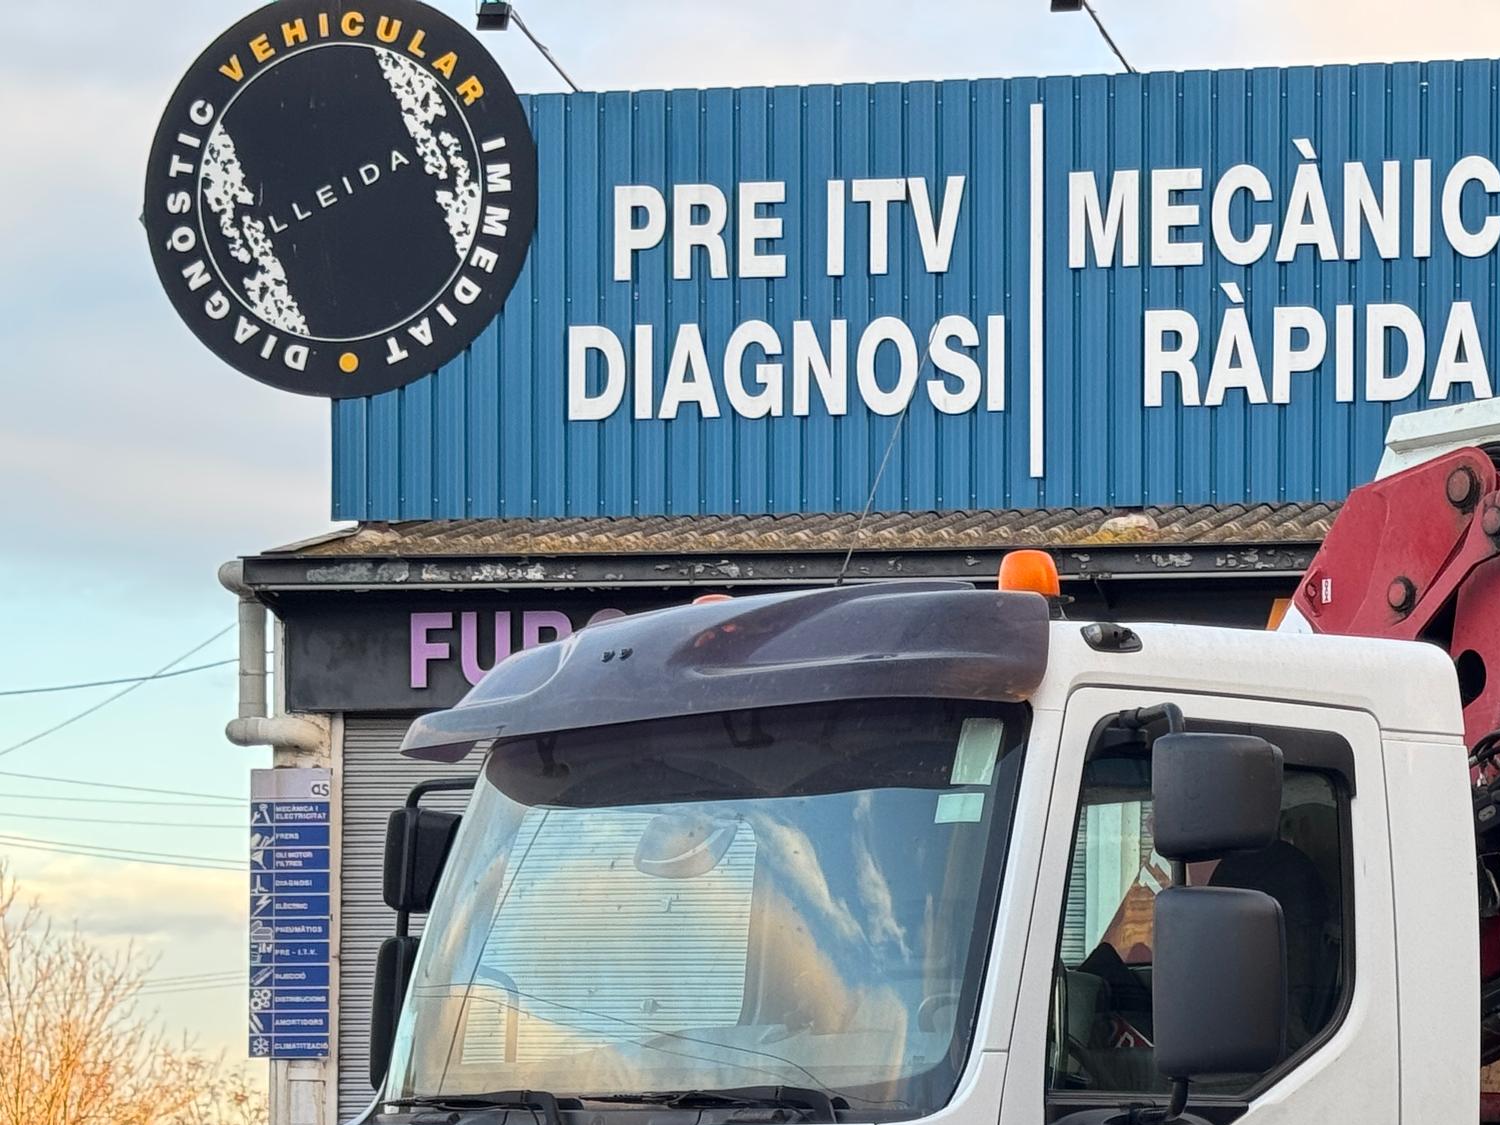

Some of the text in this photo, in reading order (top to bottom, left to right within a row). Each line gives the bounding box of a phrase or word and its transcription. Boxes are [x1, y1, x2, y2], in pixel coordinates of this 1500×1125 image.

[219, 11, 485, 106] VEHICULAR
[167, 99, 311, 371] DIAGNÒSTIC
[268, 150, 409, 234] LLEIDA
[614, 175, 965, 281] PRE ITV
[386, 137, 512, 364] IMMEDIAT
[568, 315, 1005, 421] DIAGNOSI
[1143, 282, 1493, 407] RÀPIDA
